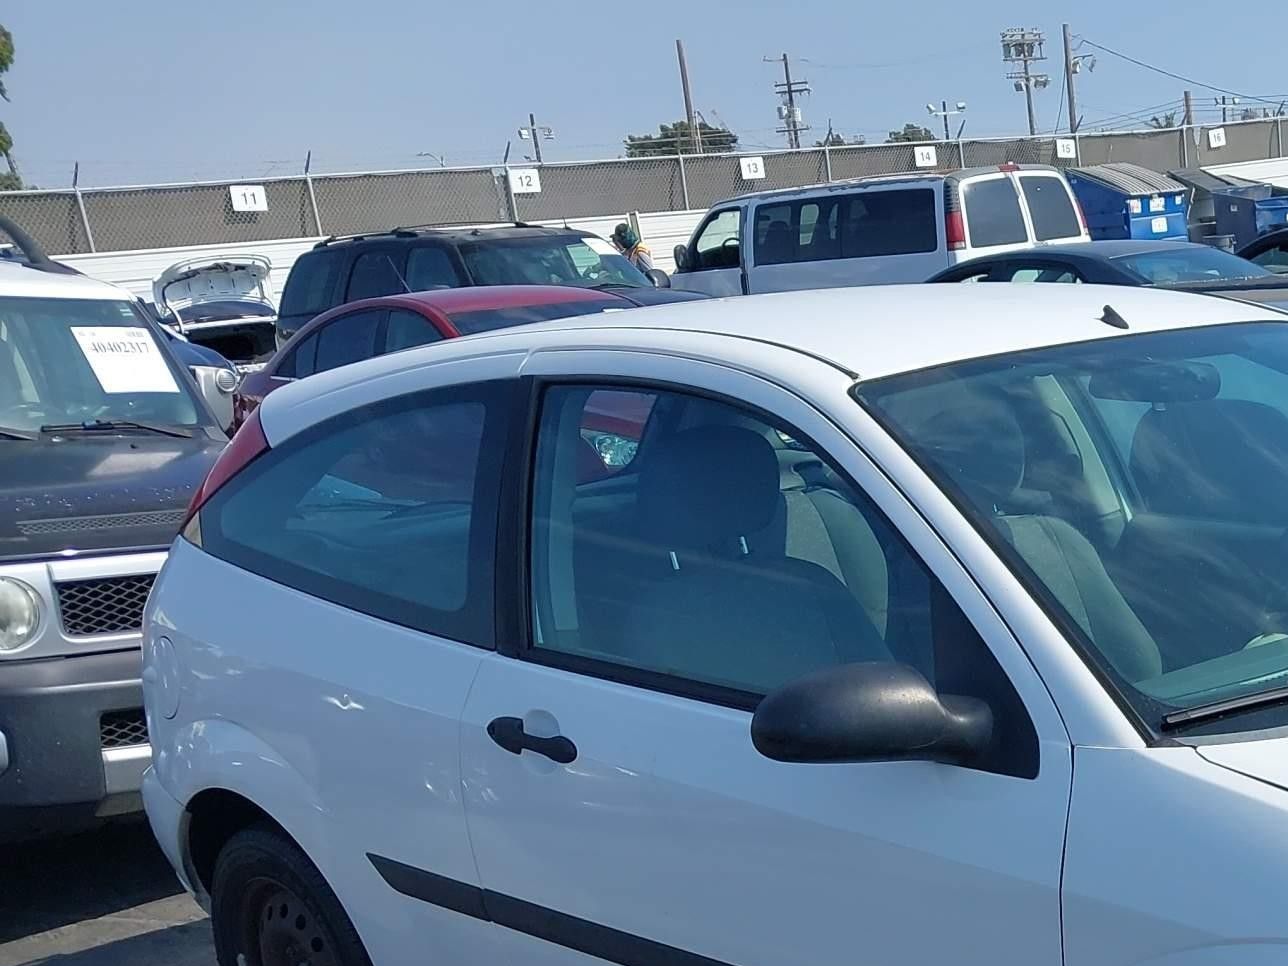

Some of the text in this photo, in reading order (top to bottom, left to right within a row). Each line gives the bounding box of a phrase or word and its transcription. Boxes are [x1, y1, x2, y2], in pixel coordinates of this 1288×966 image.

[1212, 132, 1222, 143] 16
[1060, 143, 1072, 155] 15
[920, 150, 932, 162] 14
[745, 162, 759, 174] 13
[517, 174, 533, 188] 12
[240, 191, 258, 206] 11
[91, 341, 150, 353] 40402317
